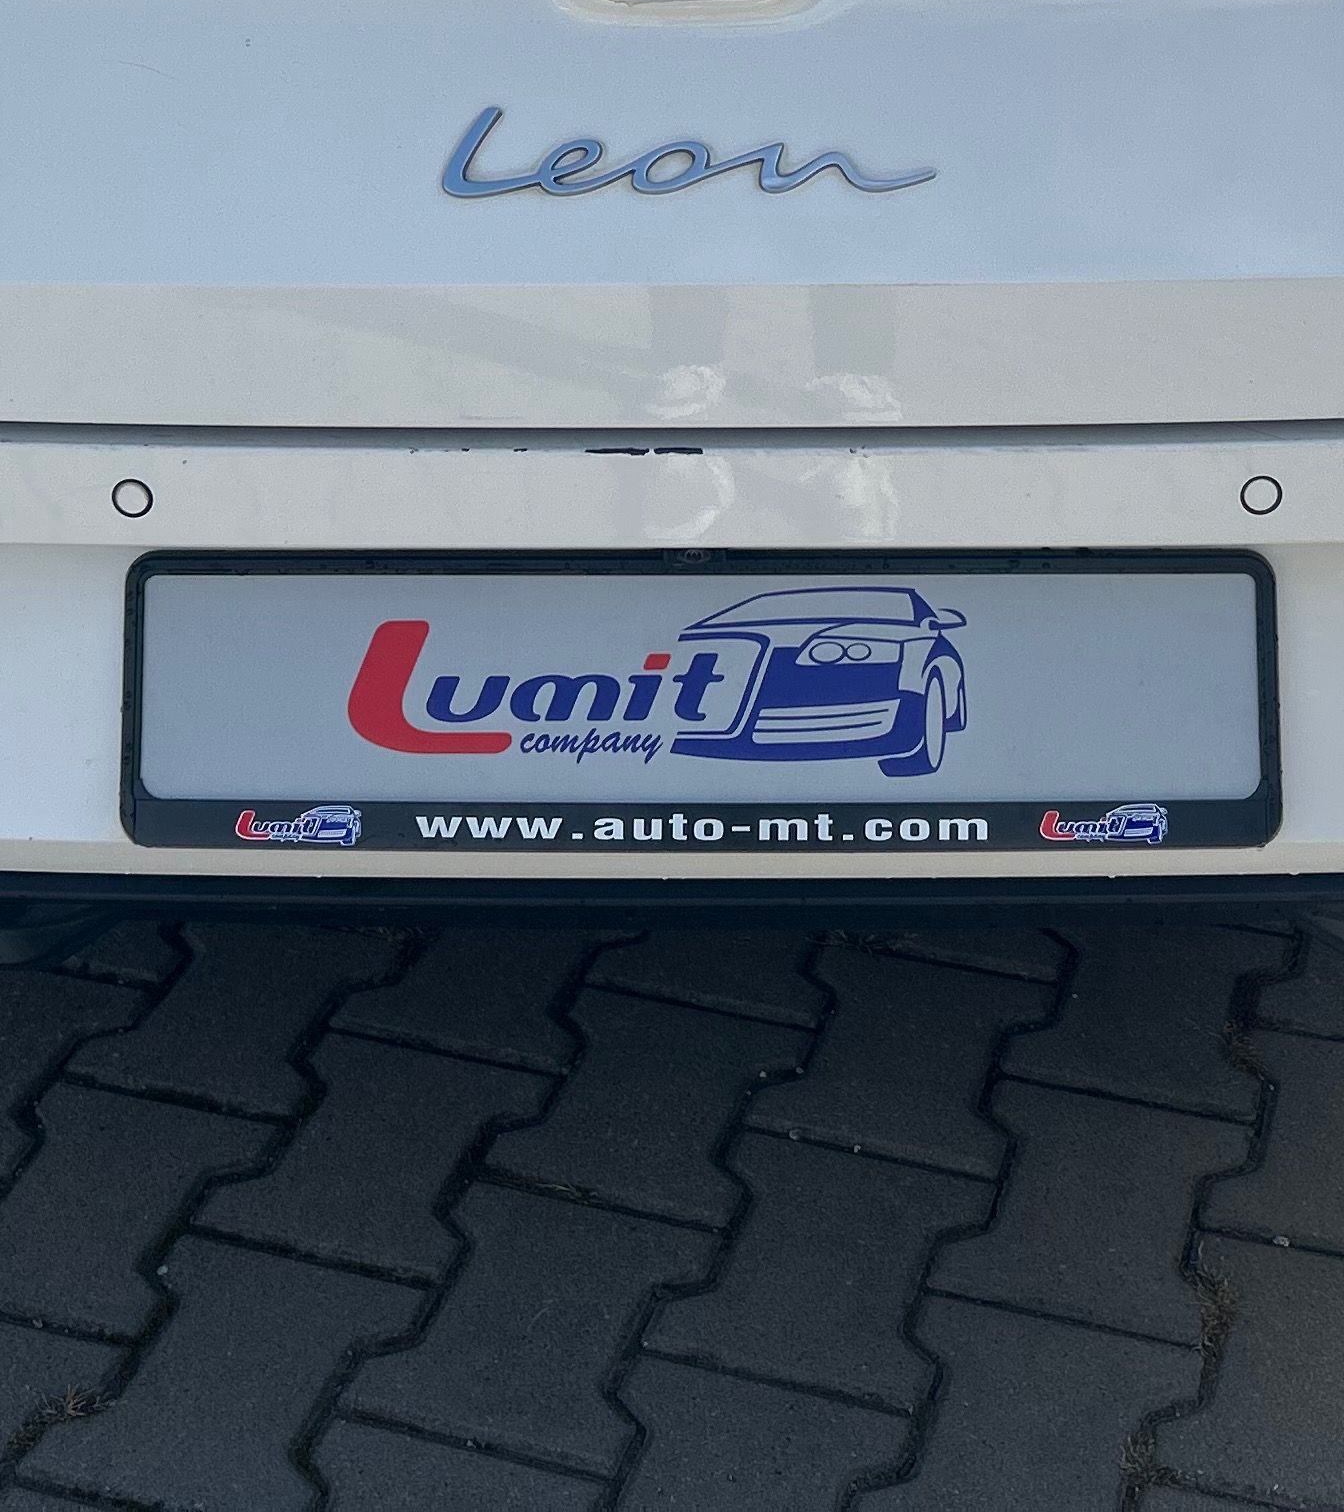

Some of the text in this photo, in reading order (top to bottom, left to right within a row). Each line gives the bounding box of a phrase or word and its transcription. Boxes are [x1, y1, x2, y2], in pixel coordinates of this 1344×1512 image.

[442, 106, 937, 199] Leon
[347, 620, 724, 754] Lumit
[519, 727, 664, 764] company
[415, 813, 989, 843] www.auto-mt.com
[1040, 811, 1122, 840] Lumit
